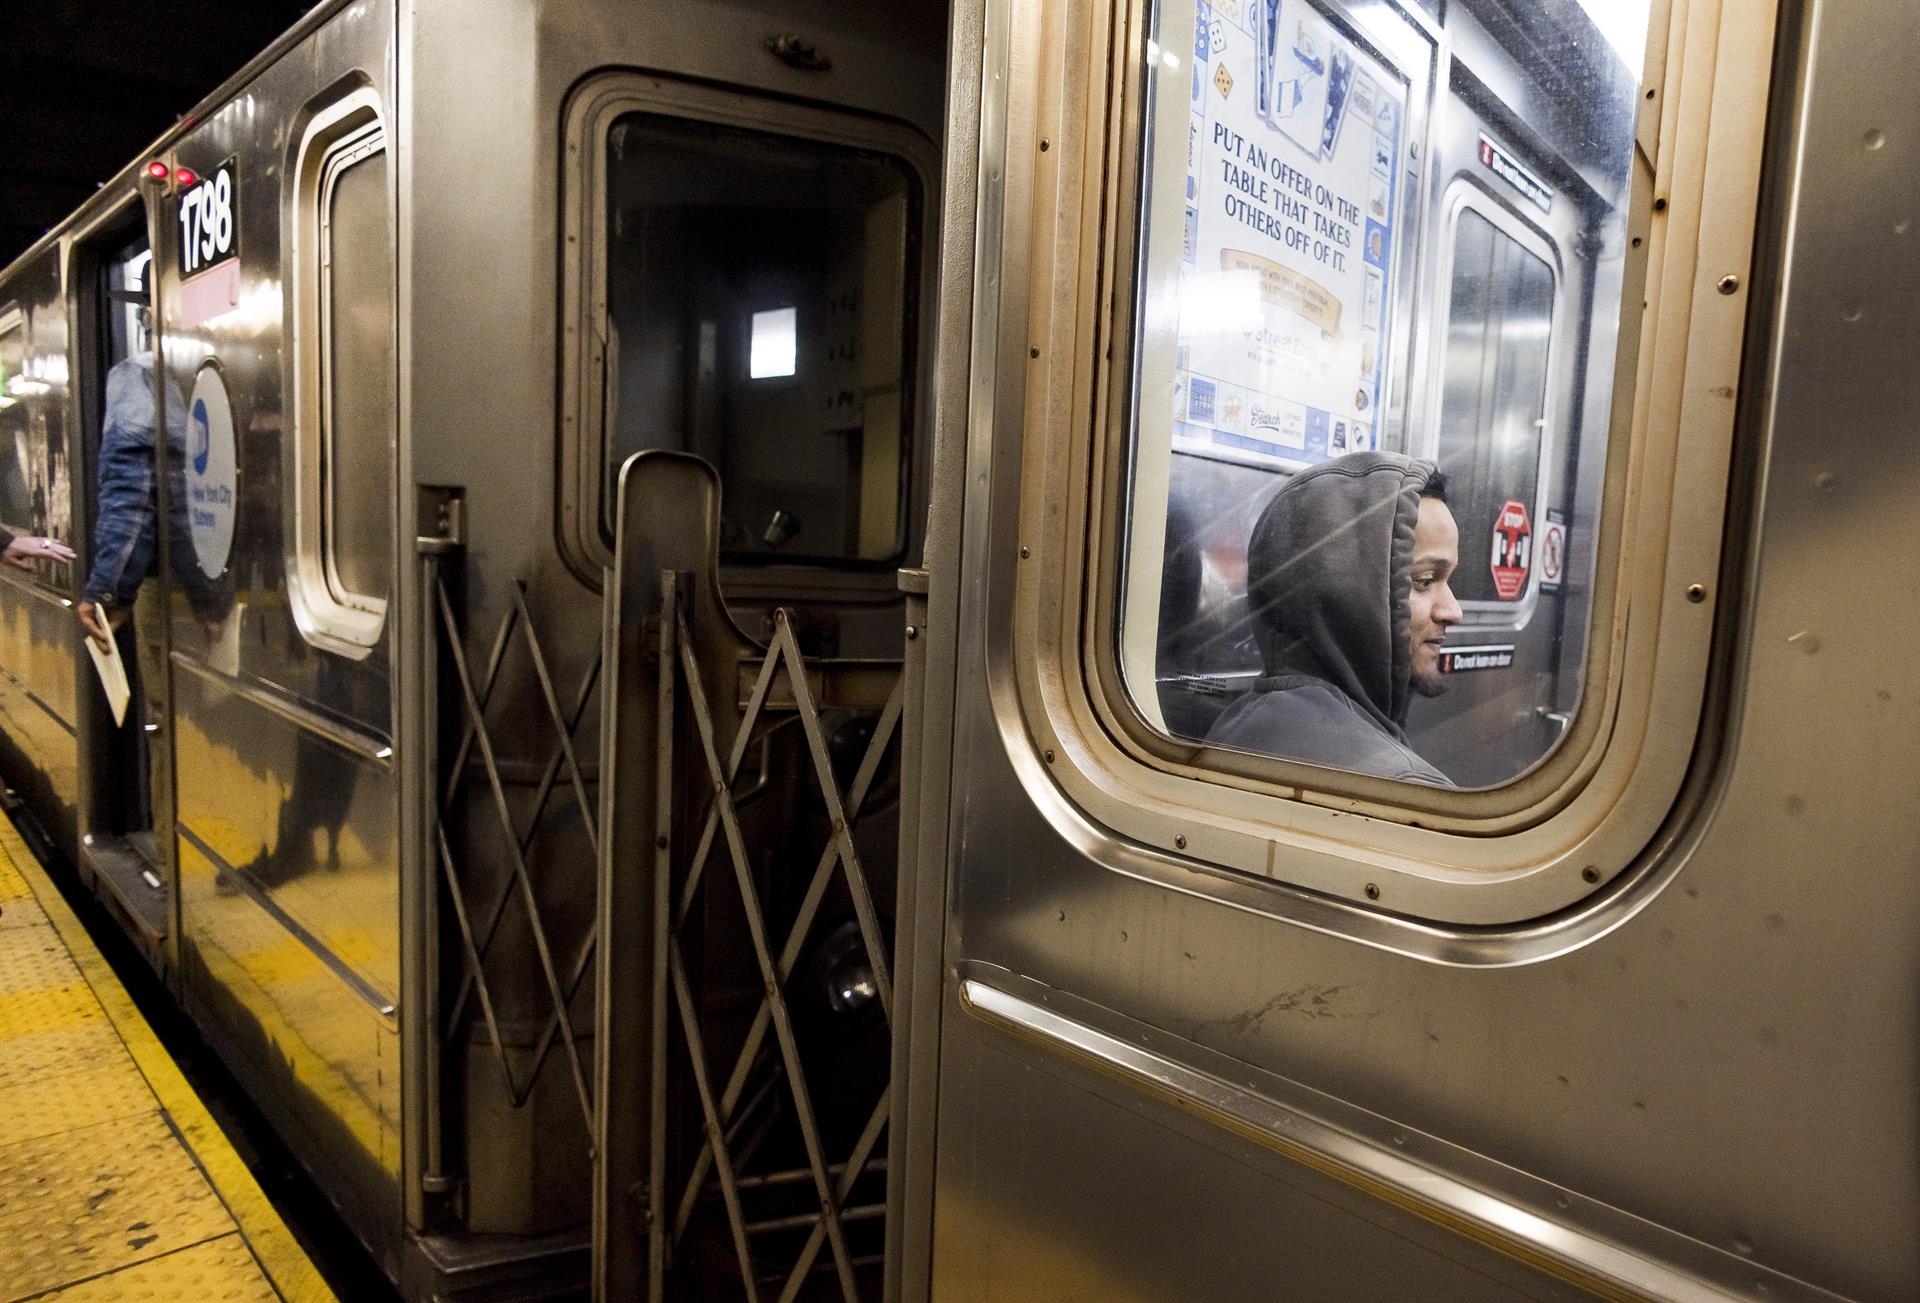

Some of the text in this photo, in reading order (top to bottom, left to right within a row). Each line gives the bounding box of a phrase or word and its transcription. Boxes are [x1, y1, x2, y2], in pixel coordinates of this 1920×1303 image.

[180, 168, 233, 273] 1798
[1213, 121, 1244, 158] PUT
[1246, 143, 1268, 173] AN
[1271, 158, 1312, 199] OFFER
[1315, 185, 1334, 211] ON
[1337, 196, 1360, 226] THE
[1221, 159, 1351, 249] TABLE THAT TAKES
[1225, 193, 1281, 241] OTHERS
[1285, 226, 1311, 254] OFF
[1313, 240, 1331, 264] OF
[1332, 250, 1347, 273] IT.
